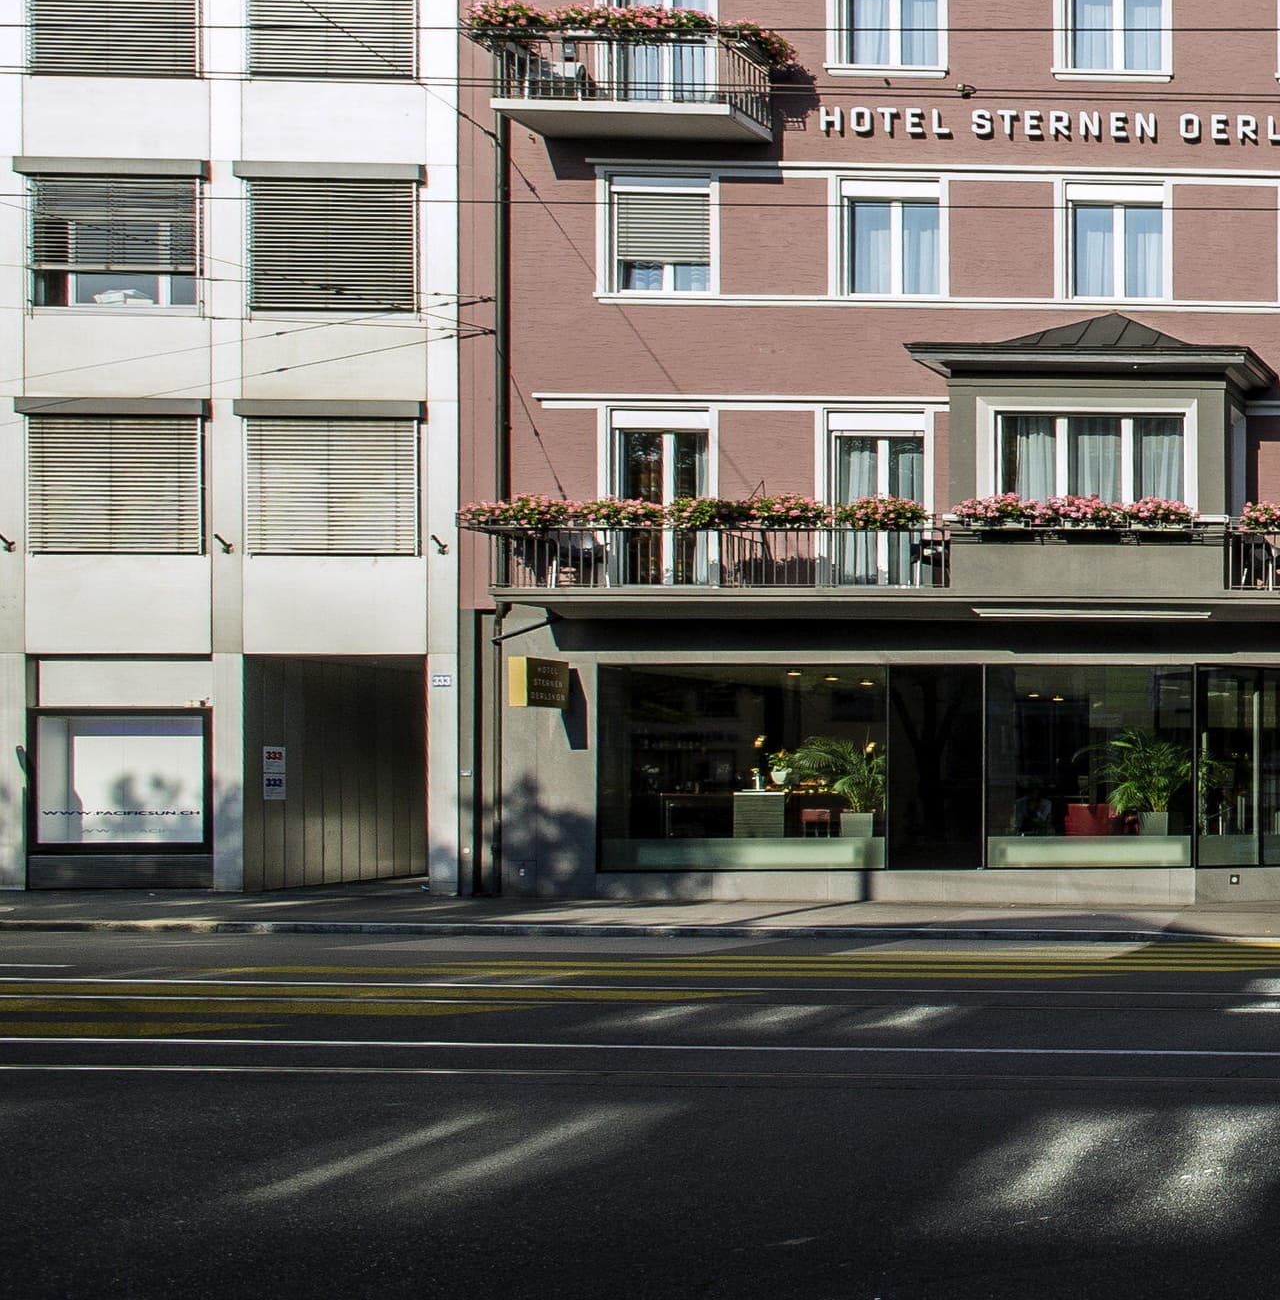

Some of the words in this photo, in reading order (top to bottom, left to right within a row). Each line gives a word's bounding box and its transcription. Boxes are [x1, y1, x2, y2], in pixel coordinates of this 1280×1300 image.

[819, 107, 953, 136] HOTEL
[971, 109, 1155, 142] STERNEN
[433, 676, 451, 686] 333
[265, 751, 284, 761] 333
[42, 809, 201, 817] WWW.PACIFICSUN.CH
